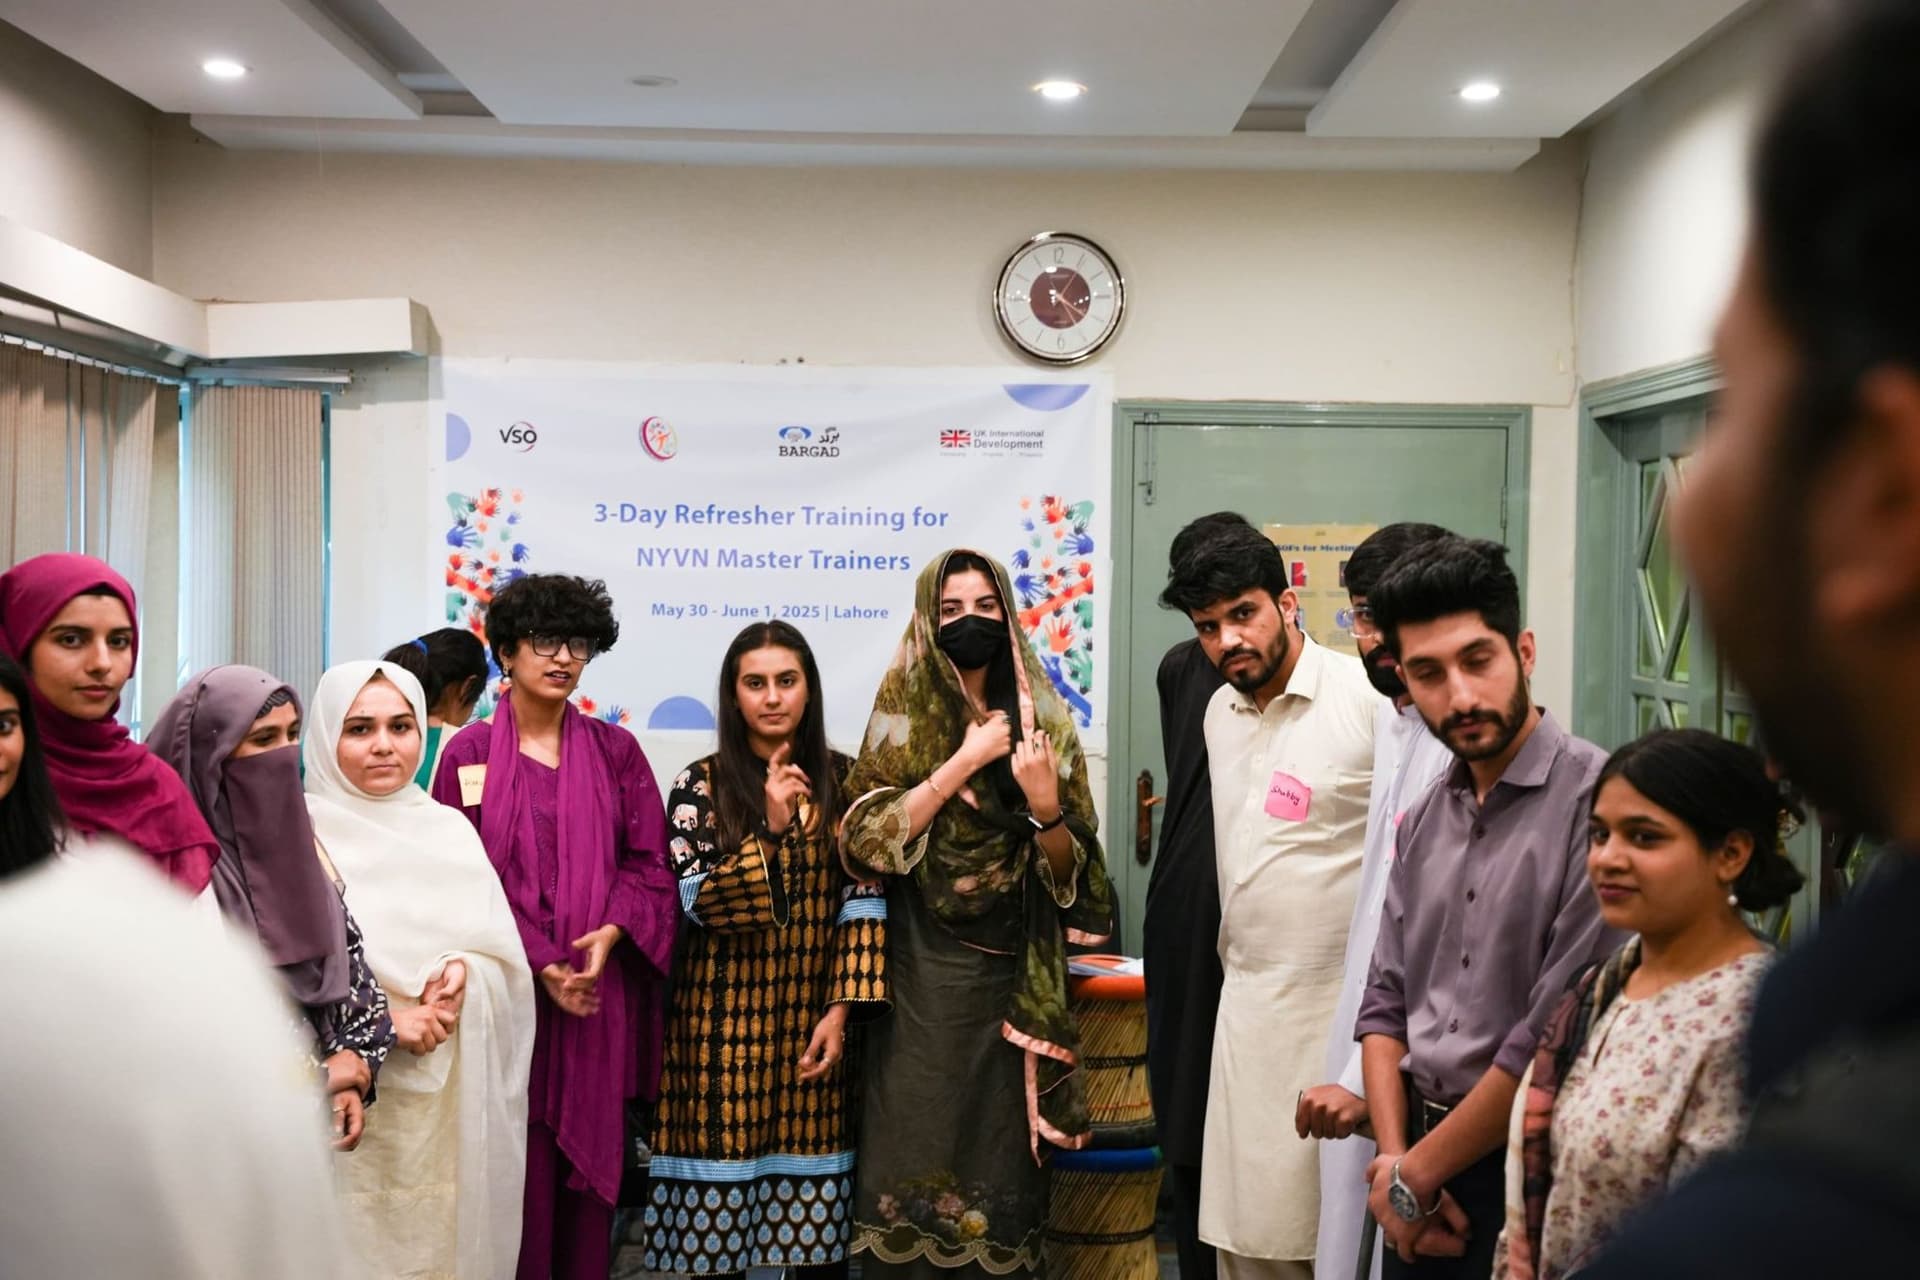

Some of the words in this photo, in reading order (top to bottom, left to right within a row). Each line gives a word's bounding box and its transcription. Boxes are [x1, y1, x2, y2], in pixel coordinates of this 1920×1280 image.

[499, 426, 537, 444] VSO
[974, 430, 986, 438] UK
[990, 429, 1045, 438] International
[778, 446, 840, 457] BARGAD
[974, 439, 1043, 450] Development
[594, 503, 668, 528] 3-Day
[675, 503, 796, 525] Refresher
[801, 505, 905, 531] Training
[912, 505, 949, 527] for
[637, 548, 709, 568] NYVN
[717, 549, 803, 569] Master
[808, 549, 910, 570] Trainers
[651, 603, 685, 619] May
[690, 604, 708, 617] 30
[721, 603, 760, 618] June
[764, 605, 776, 621] 1,
[781, 605, 820, 618] 2025
[834, 605, 889, 619] Lahore
